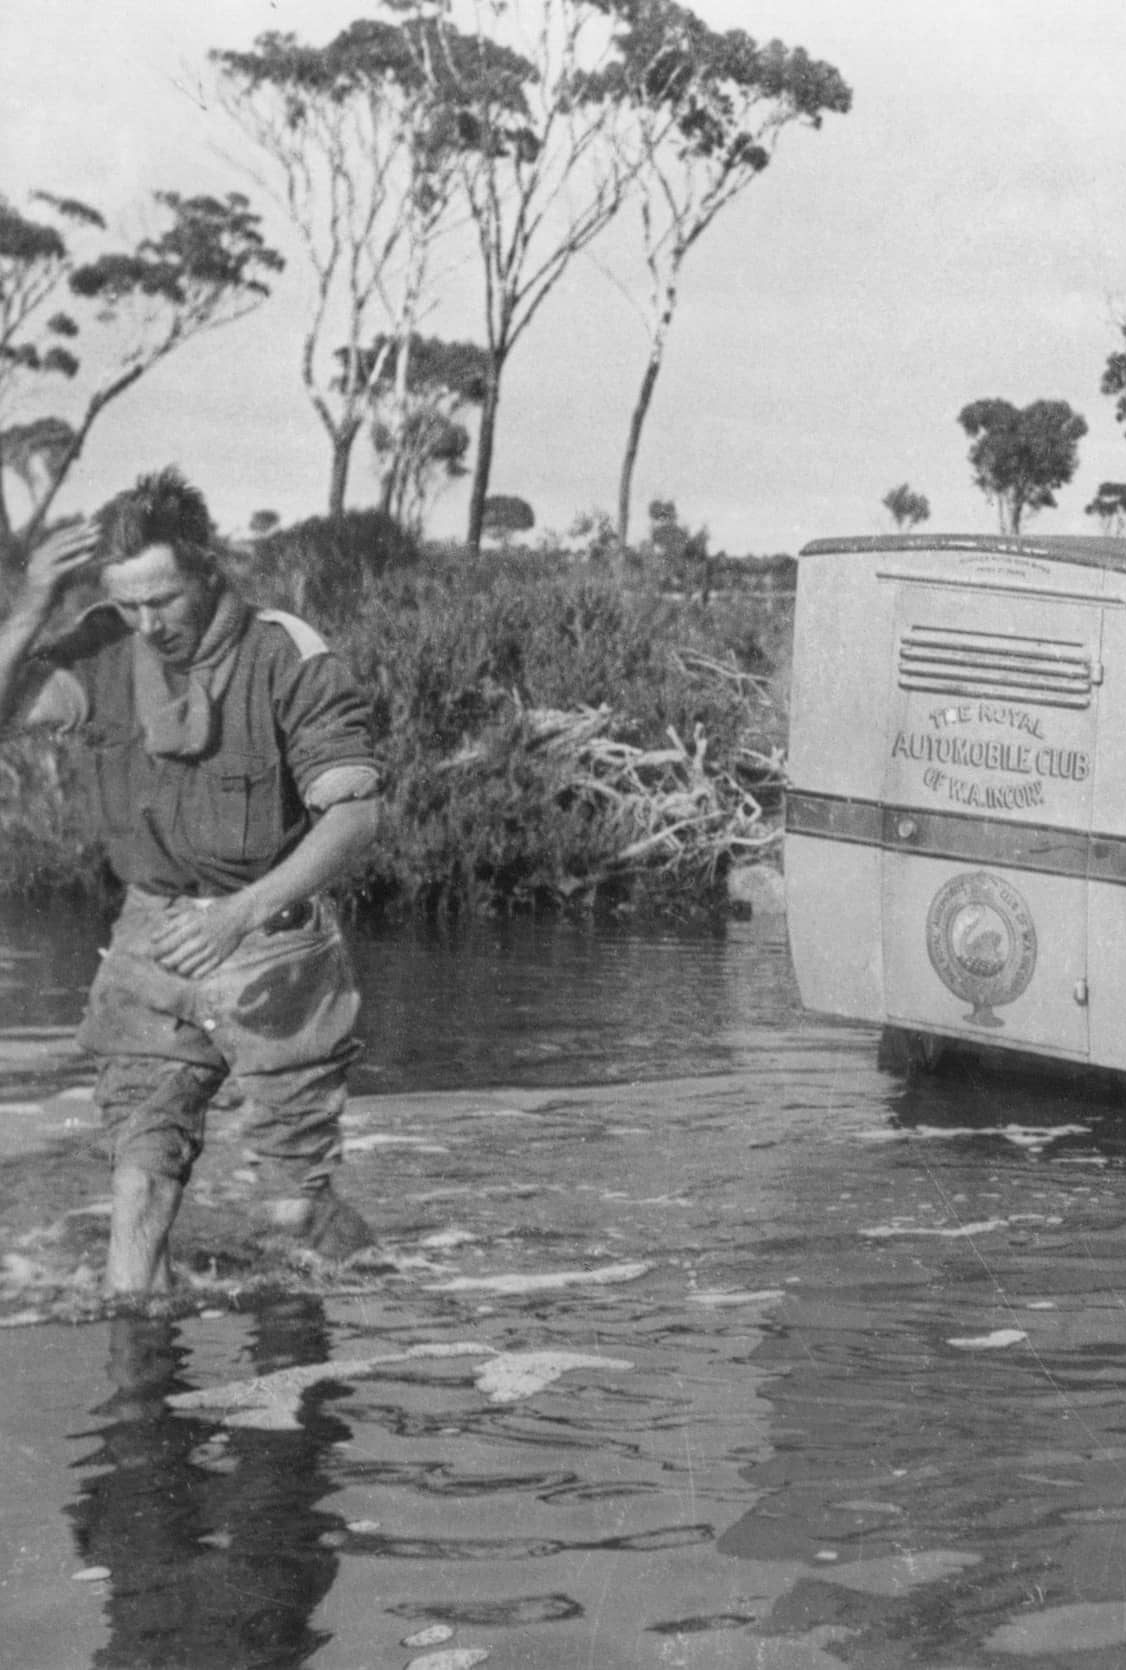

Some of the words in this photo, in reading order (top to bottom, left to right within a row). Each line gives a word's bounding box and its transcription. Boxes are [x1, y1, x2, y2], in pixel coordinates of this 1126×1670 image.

[978, 702, 1046, 741] ROYAL
[891, 730, 1032, 775] AUTOMOBILE
[1035, 747, 1091, 782] CLUB
[923, 766, 948, 792] OF
